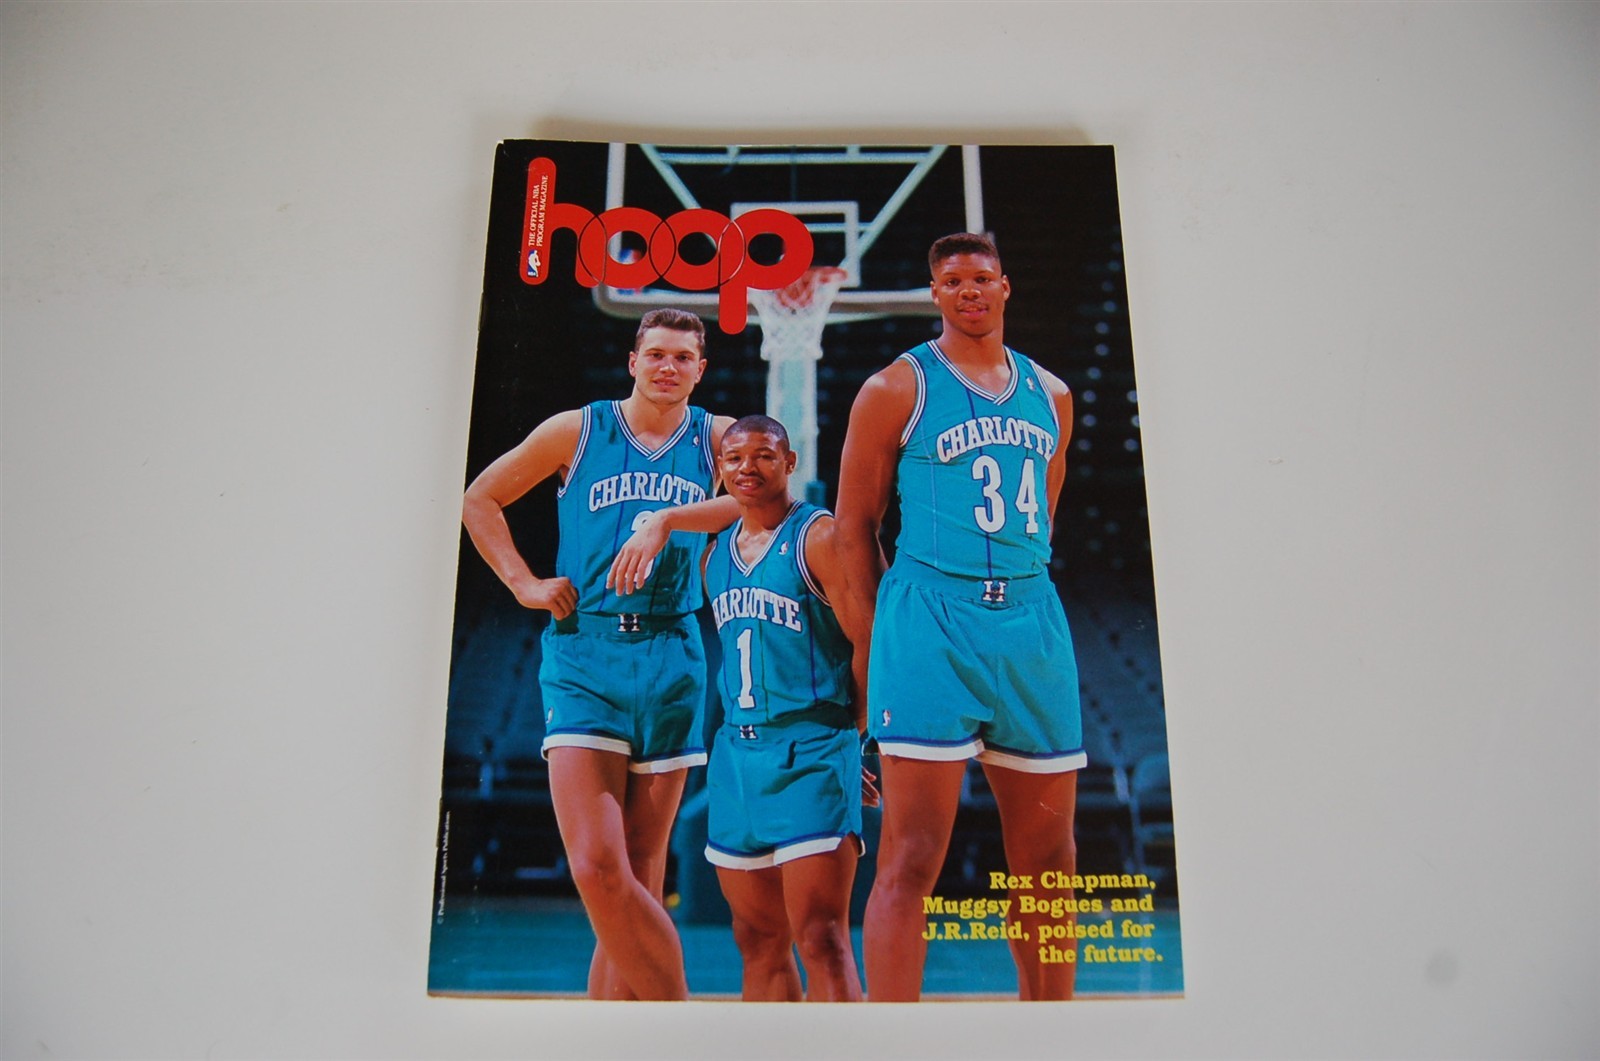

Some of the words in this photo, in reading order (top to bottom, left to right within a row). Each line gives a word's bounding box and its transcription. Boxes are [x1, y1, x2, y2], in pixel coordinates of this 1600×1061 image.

[532, 184, 540, 199] NBA
[539, 175, 548, 211] MAGAZINE
[530, 200, 538, 231] OFFICIAL
[537, 212, 545, 247] PROGRAM
[519, 156, 814, 335] hoop
[528, 232, 536, 247] THE
[936, 415, 1054, 464] CHARLOTTE
[971, 454, 1039, 535] 34
[711, 586, 803, 633] HARLOTTE
[736, 628, 757, 710] 1
[438, 875, 446, 916] Professional
[989, 871, 1033, 890] Rex
[1040, 871, 1157, 893] Chapman,
[922, 895, 1012, 919] Muggsy
[1019, 895, 1103, 919] Bogues
[1110, 894, 1154, 913] and
[921, 920, 1031, 941] J.R.Reid,
[1038, 919, 1114, 943] poised
[1121, 919, 1156, 938] for
[1038, 945, 1077, 964] the
[1084, 944, 1164, 963] future.
